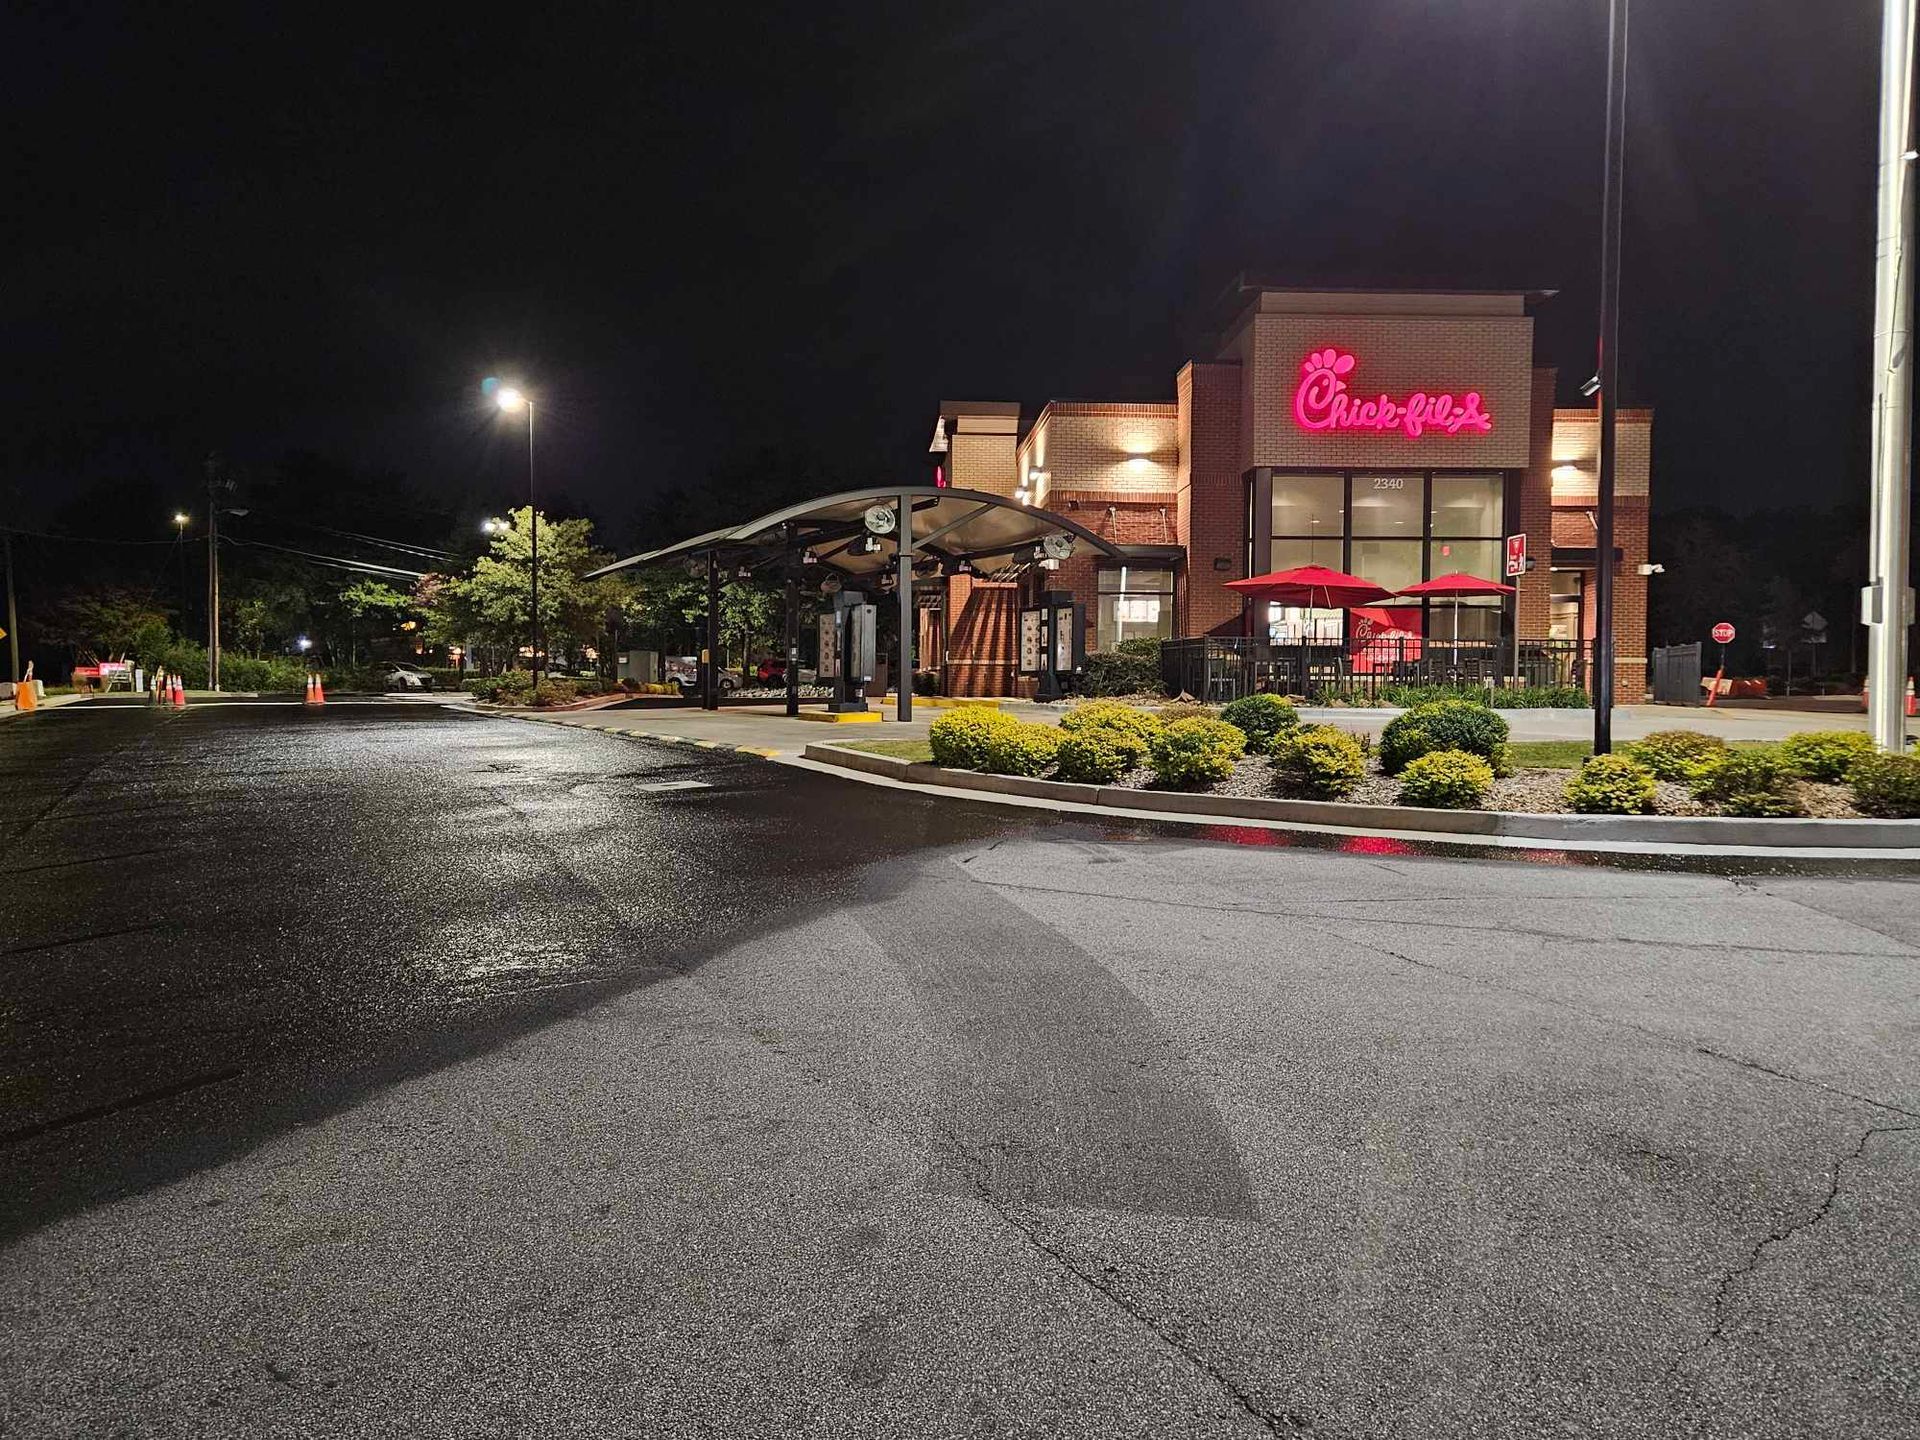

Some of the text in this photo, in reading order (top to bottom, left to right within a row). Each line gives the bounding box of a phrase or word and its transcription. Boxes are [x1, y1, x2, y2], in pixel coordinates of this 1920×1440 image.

[1296, 349, 1492, 436] Chick-fil-A
[1373, 478, 1404, 490] 2340
[1713, 629, 1734, 638] STOP
